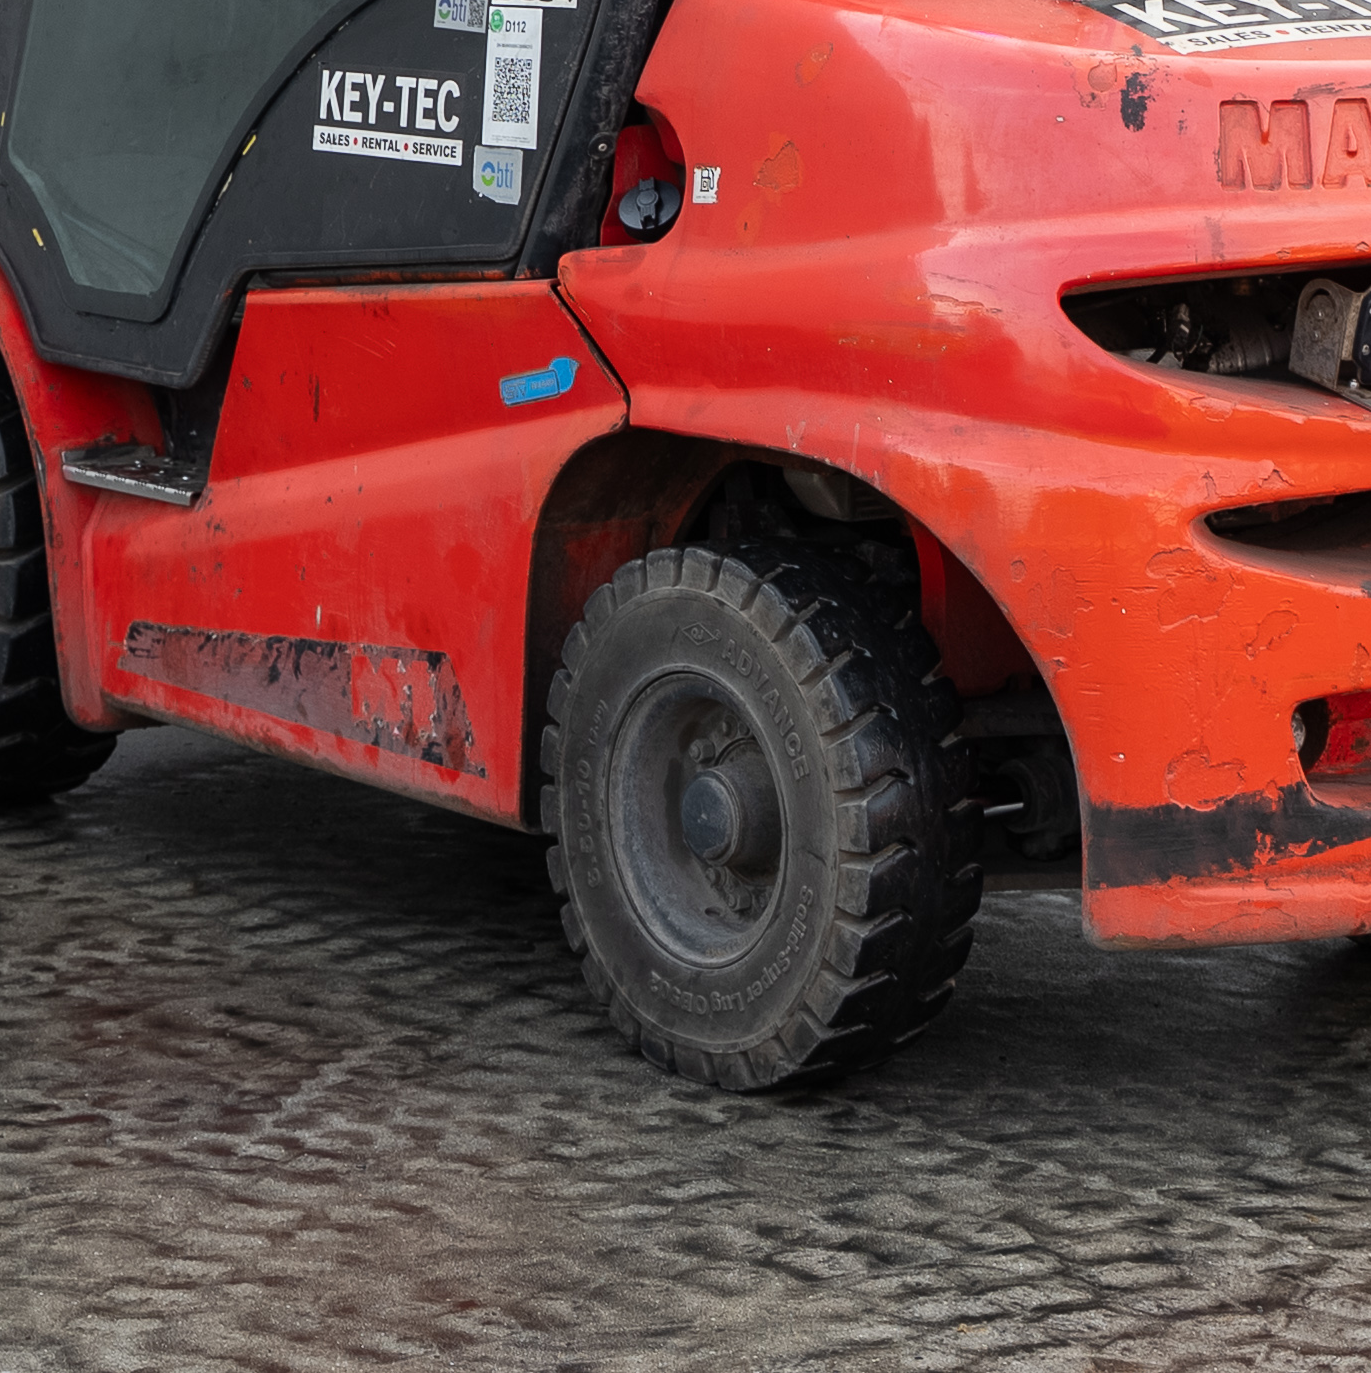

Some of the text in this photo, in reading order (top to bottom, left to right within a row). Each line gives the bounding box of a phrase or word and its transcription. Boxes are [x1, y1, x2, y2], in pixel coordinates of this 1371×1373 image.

[505, 20, 527, 33] D112
[1188, 28, 1270, 48] SALES
[319, 69, 460, 133] KEY-TEC
[319, 132, 457, 158] SALES RENTAL SERVICE
[721, 638, 810, 780] ADVANCE
[709, 989, 745, 1014] Lug
